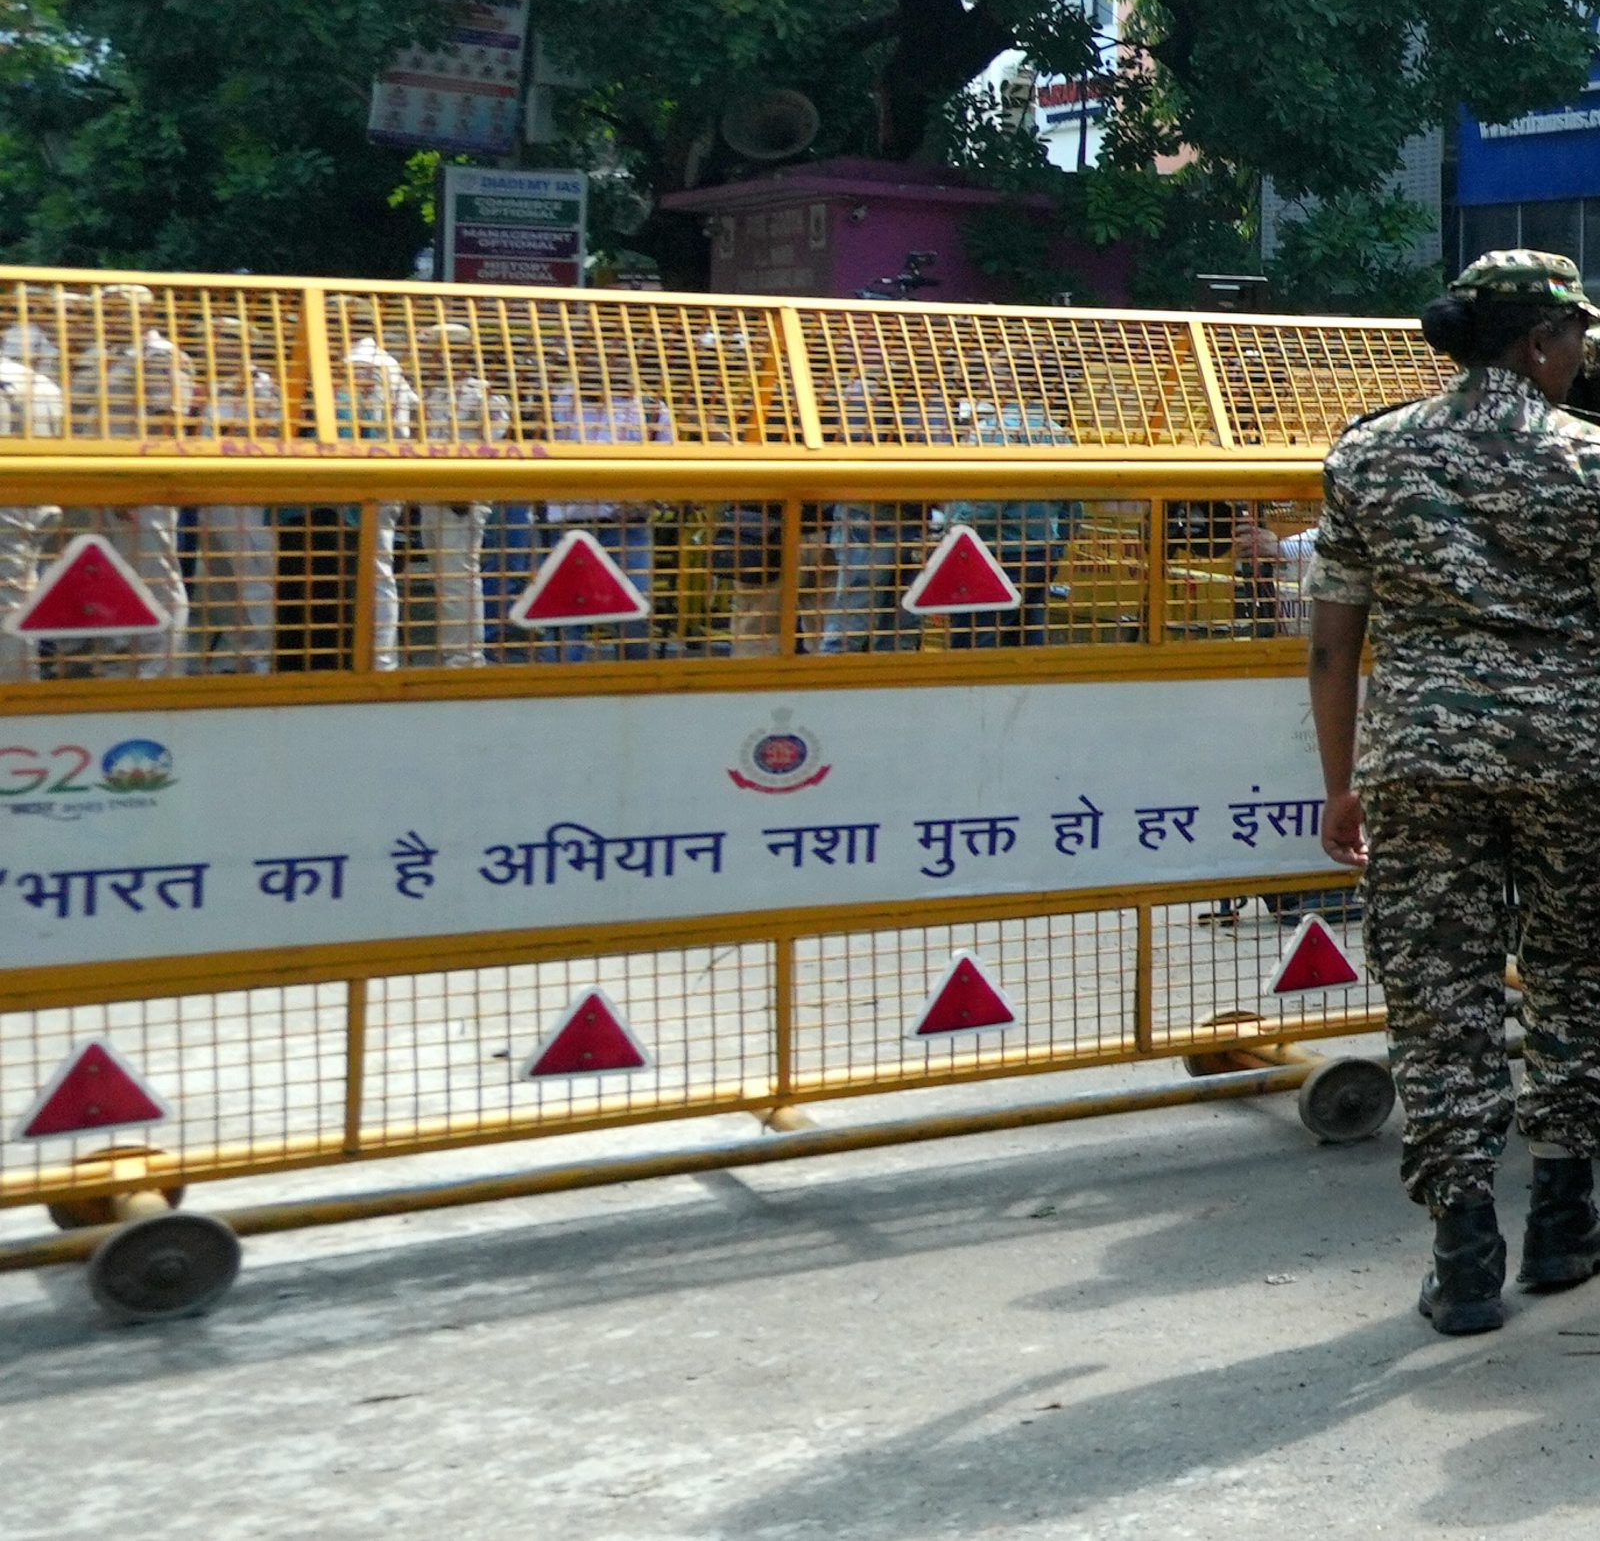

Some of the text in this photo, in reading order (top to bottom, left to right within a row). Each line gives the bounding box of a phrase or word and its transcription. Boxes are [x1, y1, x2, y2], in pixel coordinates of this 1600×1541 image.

[463, 229, 573, 243] MANAGEMENT
[255, 854, 349, 904] का
[391, 829, 438, 899] है
[480, 822, 727, 888] अभियान
[762, 822, 879, 867] नशा
[914, 815, 1020, 879] मुक्त
[1051, 794, 1104, 856] हो
[1134, 805, 1200, 850] हर
[1228, 784, 1325, 849] इंसा
